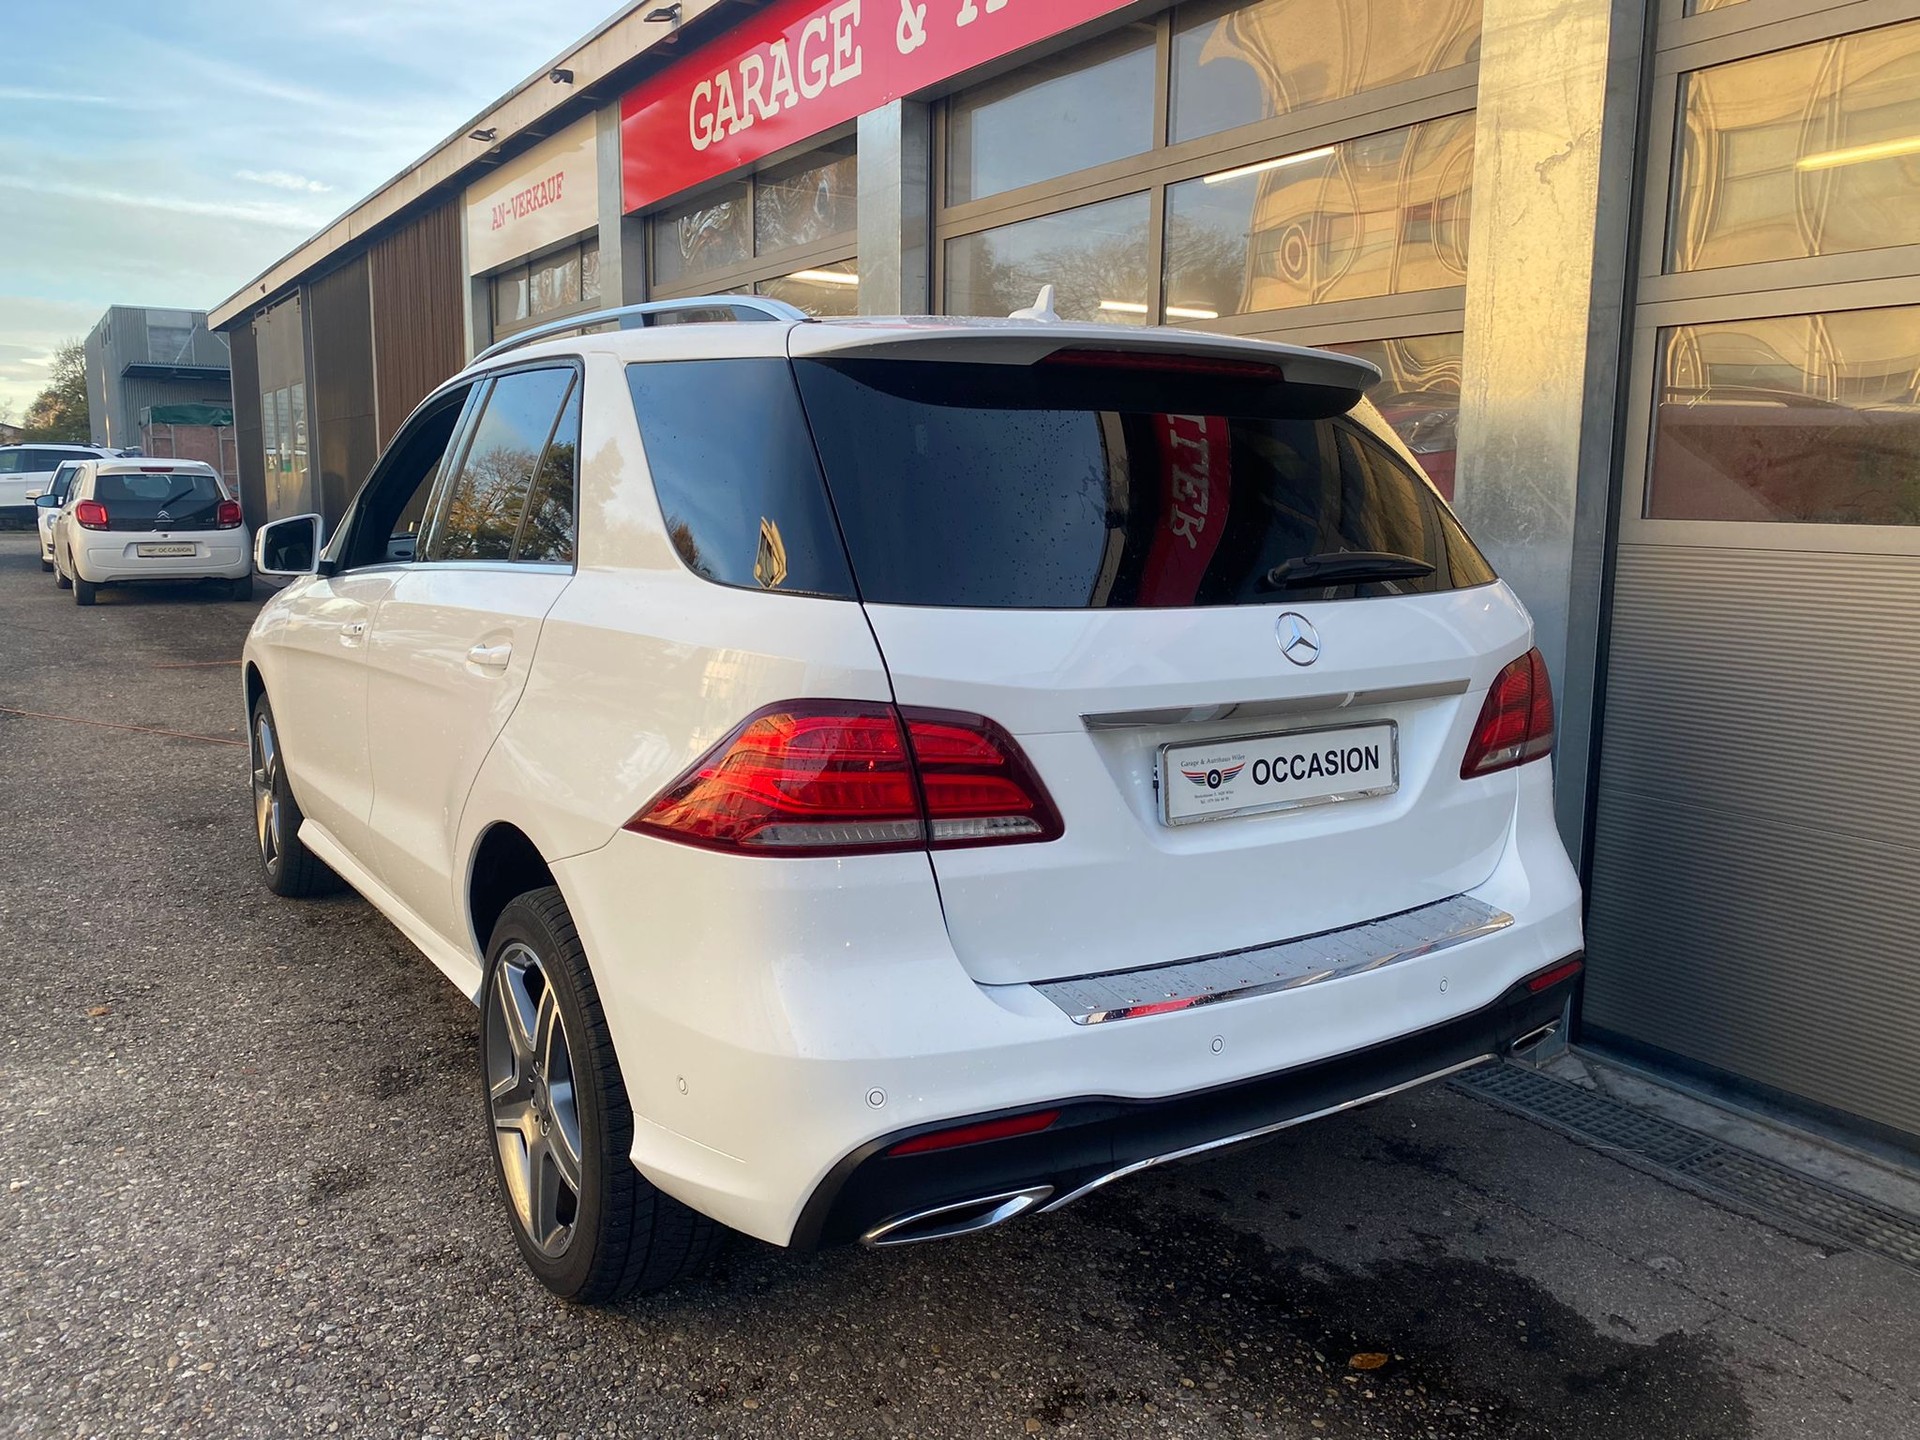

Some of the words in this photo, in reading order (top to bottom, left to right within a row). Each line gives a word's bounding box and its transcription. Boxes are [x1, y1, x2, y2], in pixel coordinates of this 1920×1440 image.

[689, 0, 862, 151] GARAGE
[896, 0, 927, 55] &
[491, 172, 564, 231] AN-VERKAUF
[158, 545, 192, 553] OCCASION
[1252, 745, 1379, 786] OCCASION
